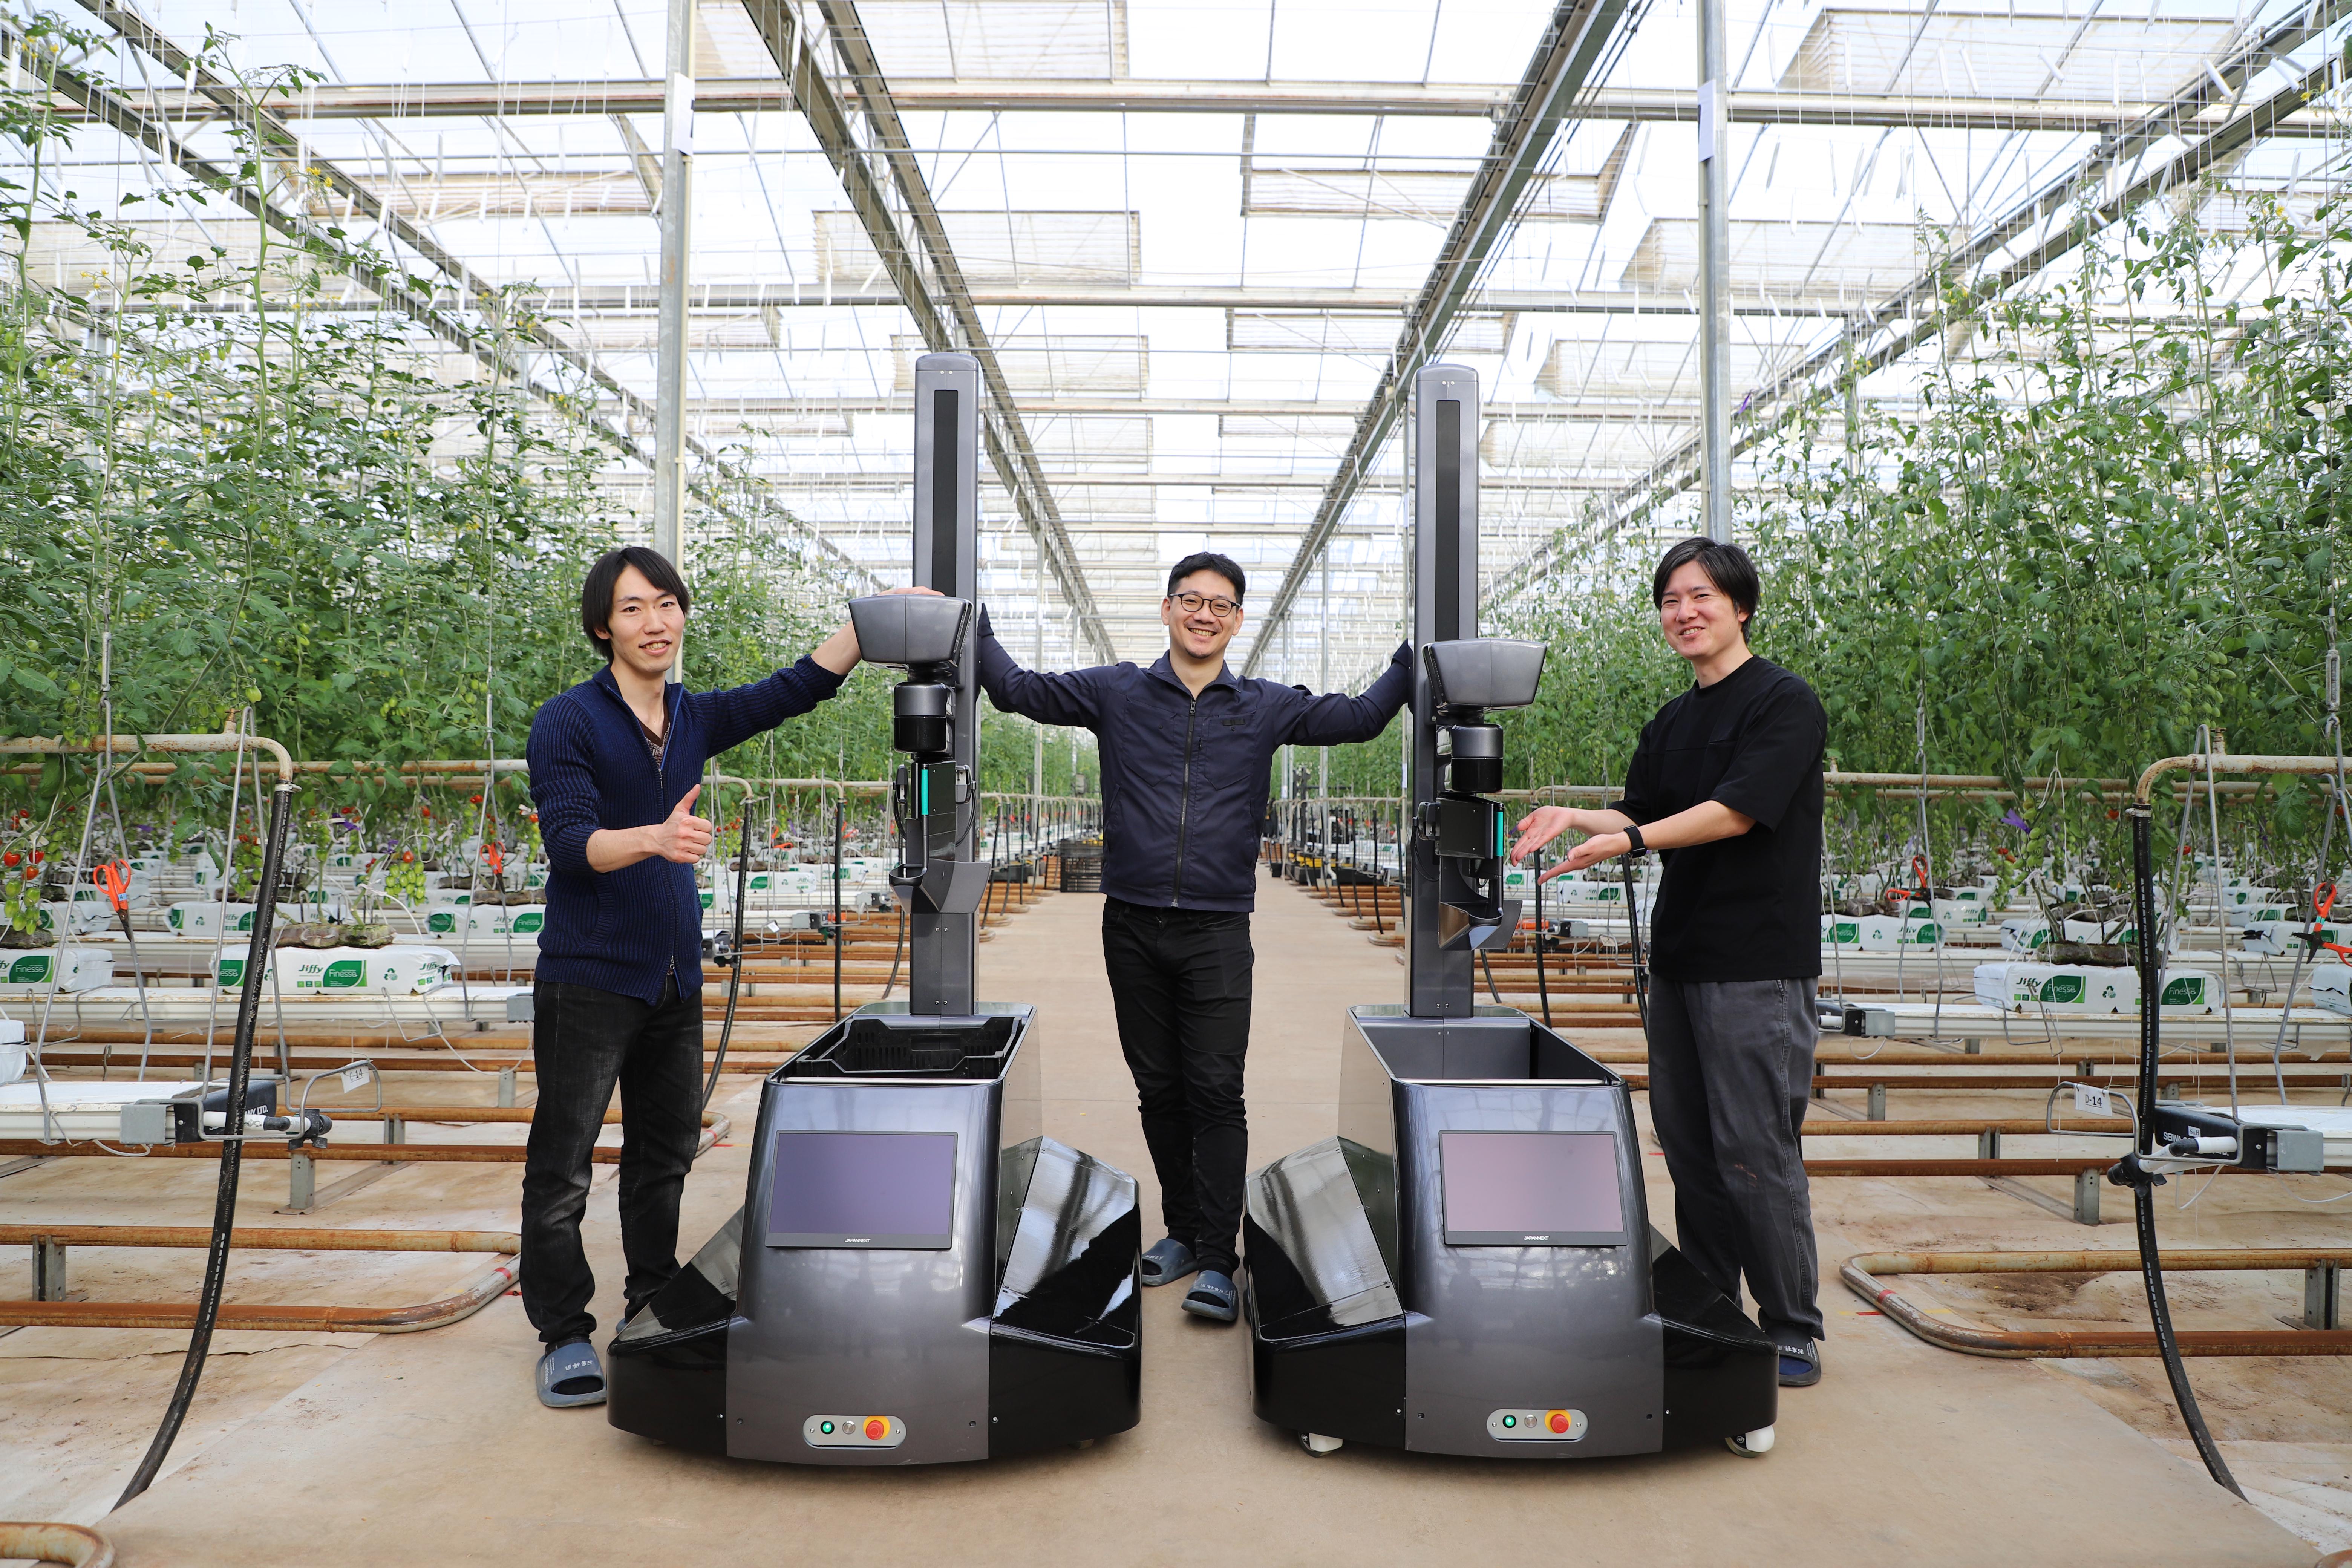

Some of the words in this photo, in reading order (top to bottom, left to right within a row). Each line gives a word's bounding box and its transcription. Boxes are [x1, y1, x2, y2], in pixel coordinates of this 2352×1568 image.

[298, 965, 323, 973] Jiffy
[329, 969, 358, 977] Finesse
[2016, 977, 2042, 987] Jiffy
[2168, 987, 2196, 995] Finesse
[2085, 1094, 2102, 1106] D-14
[257, 1104, 268, 1115] LTD.
[2163, 1132, 2181, 1142] SEIWA
[1777, 1344, 1804, 1355] お客様用
[565, 1359, 593, 1371] お客様用
